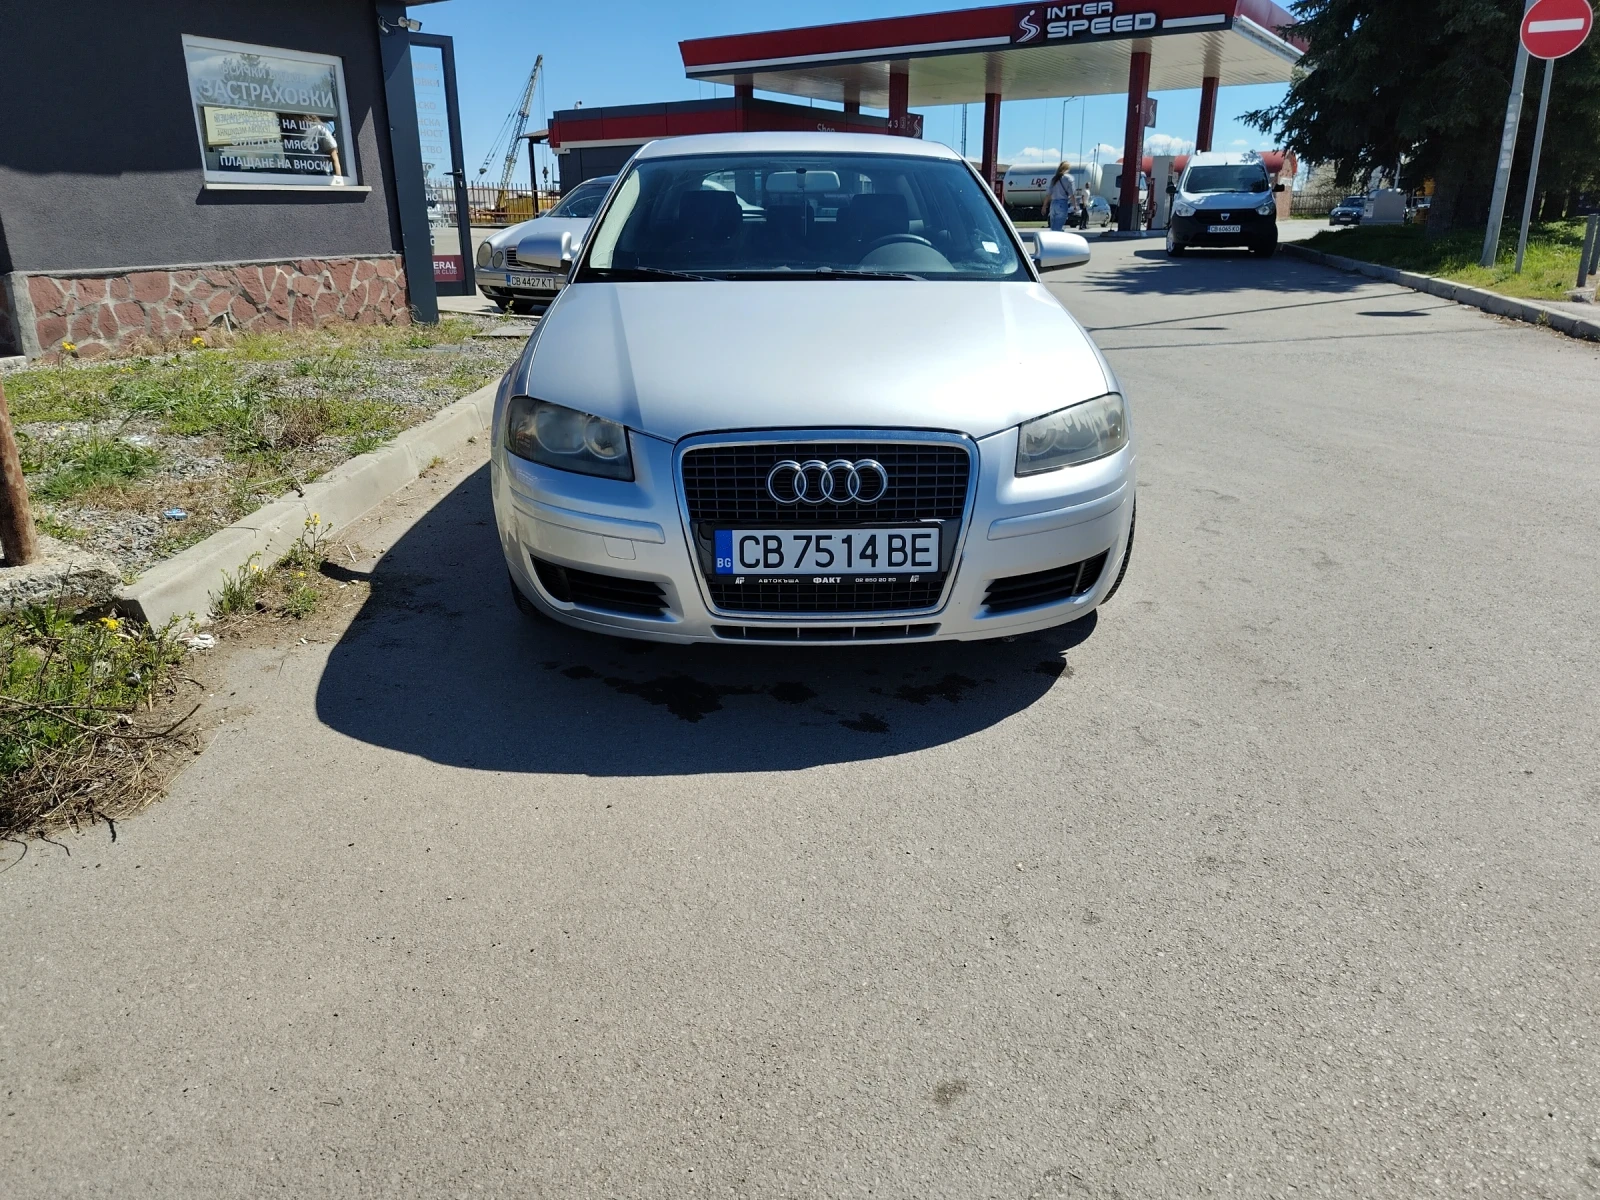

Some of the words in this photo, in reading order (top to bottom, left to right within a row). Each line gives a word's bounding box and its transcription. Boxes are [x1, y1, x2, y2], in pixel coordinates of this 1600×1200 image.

[1047, 2, 1113, 19] INTER
[1047, 12, 1156, 39] SPEED
[221, 64, 266, 79] ВСИЧКИ
[202, 78, 334, 109] ЗАСТРАХОВКИ
[282, 119, 297, 129] НА
[220, 155, 275, 169] ПЛАЩАНЕ
[278, 158, 292, 169] НА
[294, 160, 333, 171] ВНОСКИ
[1031, 178, 1047, 186] LPG
[511, 277, 521, 286] CB
[522, 277, 540, 287] 4427
[541, 278, 552, 288] KT
[739, 535, 785, 569] CB
[793, 534, 879, 568] 7514
[887, 533, 932, 567] BE
[717, 558, 732, 568] BG
